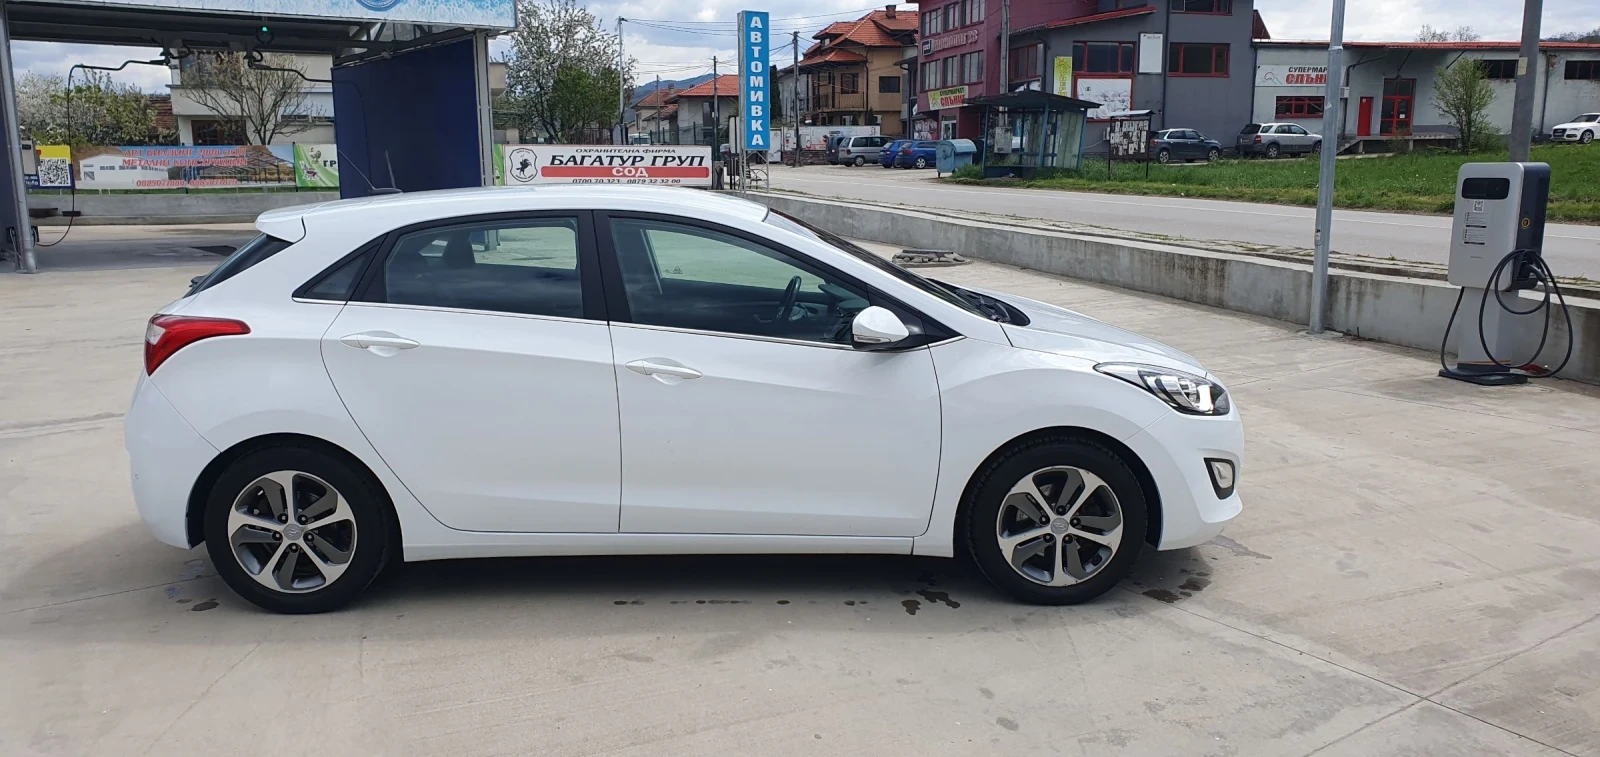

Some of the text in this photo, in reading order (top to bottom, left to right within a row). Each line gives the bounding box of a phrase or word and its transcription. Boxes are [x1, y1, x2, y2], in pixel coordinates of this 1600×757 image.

[750, 16, 764, 146] АВТОМИВКА
[1285, 74, 1327, 84] СЛЪН
[939, 87, 965, 97] СУПЕРМАРКЕТ
[124, 149, 142, 157] АРТ
[146, 148, 193, 156] БИЛДИНГ
[197, 148, 221, 156] 2008
[173, 158, 248, 167] КОНСТРУКЦИИ
[549, 155, 705, 166] БАГАТУР ГРУП
[612, 167, 649, 178] СОД
